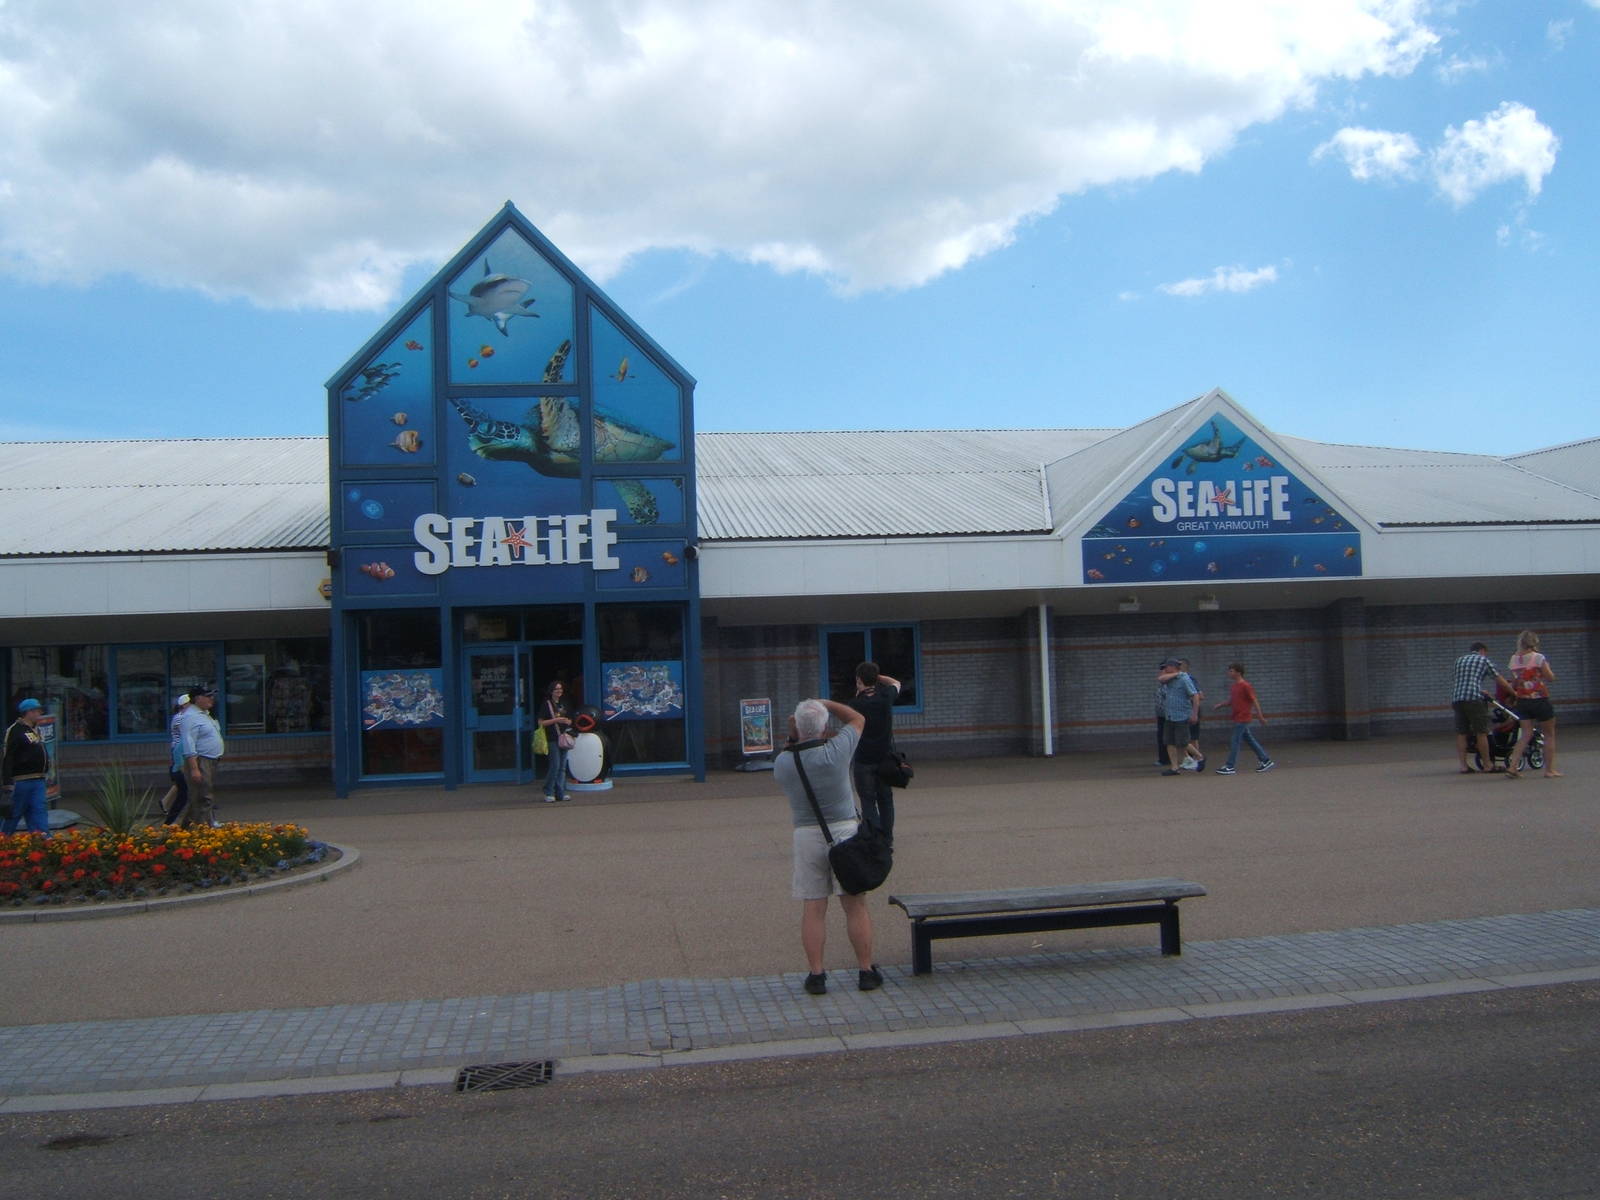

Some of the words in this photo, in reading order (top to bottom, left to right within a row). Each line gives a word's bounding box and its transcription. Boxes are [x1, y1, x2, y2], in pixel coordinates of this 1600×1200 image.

[1151, 477, 1219, 523] SEA
[413, 513, 512, 575] SEA
[1177, 521, 1209, 531] GREAT
[1213, 520, 1269, 530] YARMOUTH
